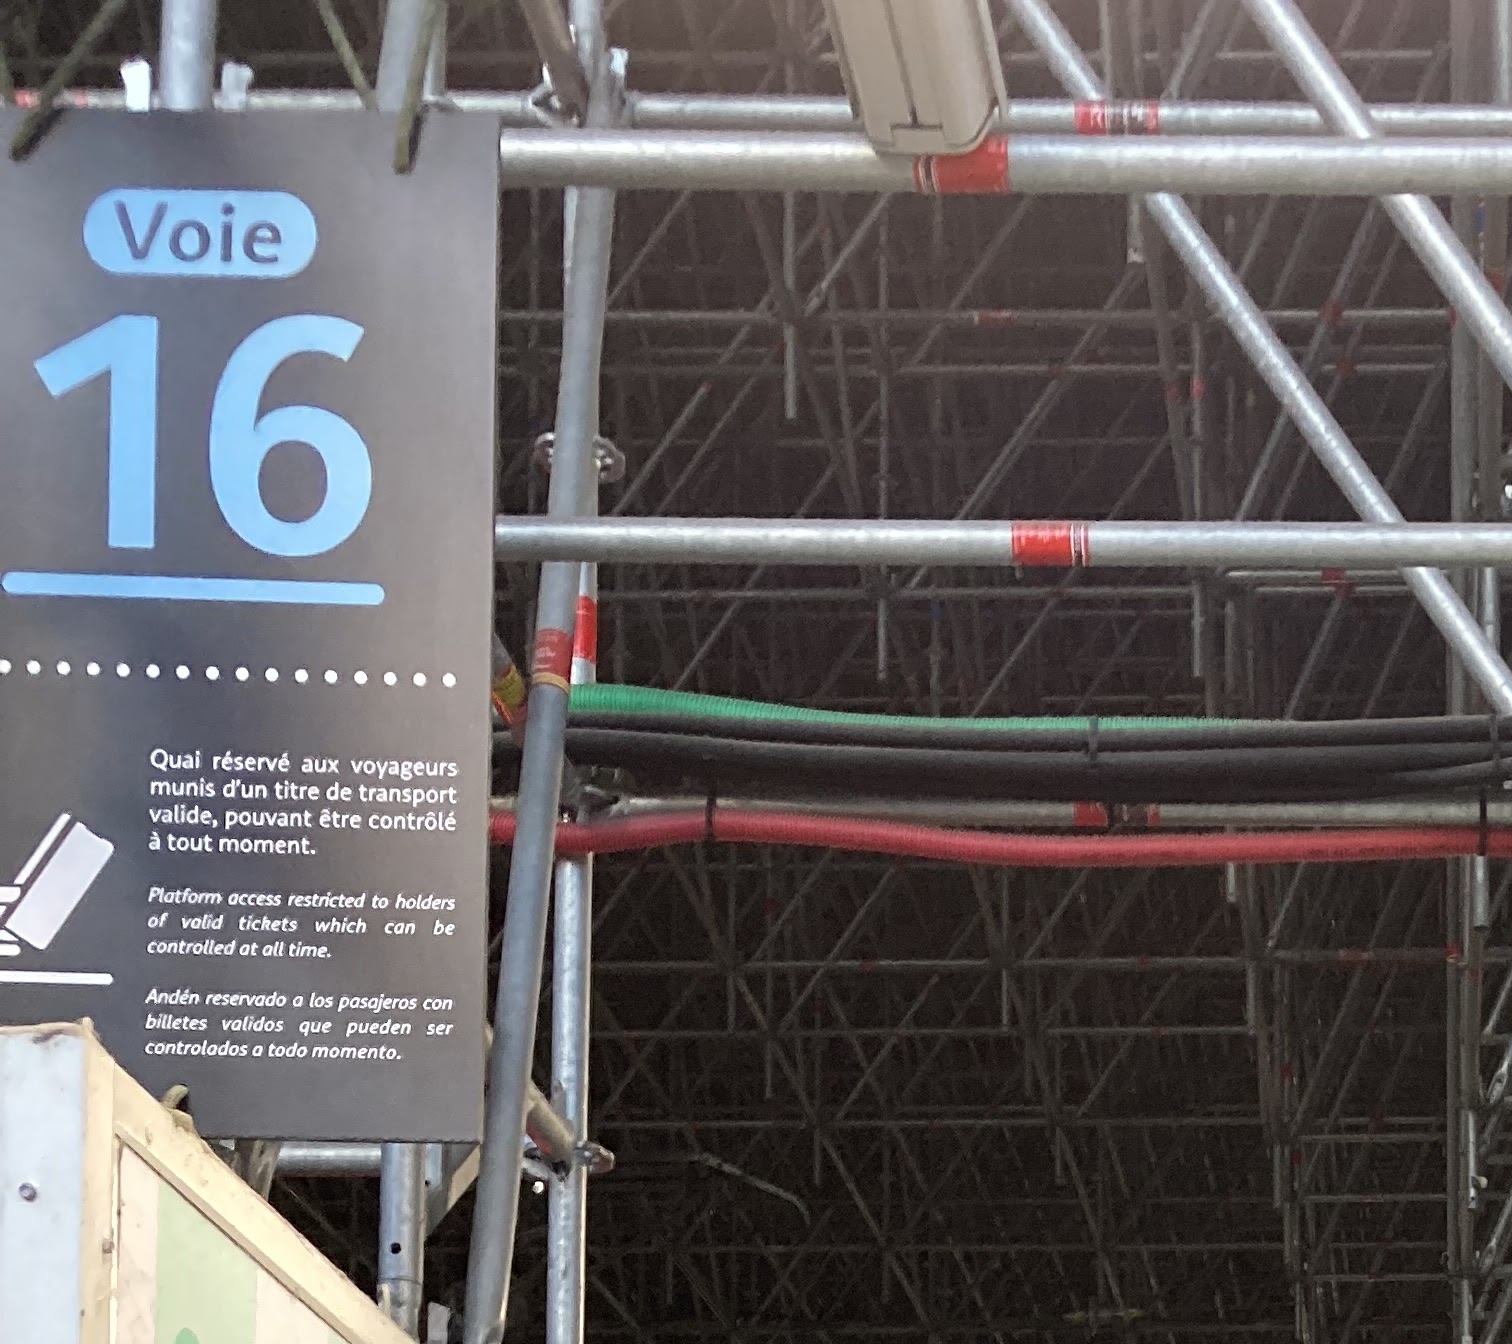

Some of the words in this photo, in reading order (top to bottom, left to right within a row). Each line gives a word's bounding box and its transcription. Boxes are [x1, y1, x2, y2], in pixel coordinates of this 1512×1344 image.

[115, 201, 283, 265] Voie
[33, 313, 373, 558] 16
[150, 748, 200, 771] Quai
[213, 750, 290, 772] réservé
[301, 757, 339, 774] aux
[351, 758, 458, 781] voyageurs
[150, 777, 215, 797] munis
[222, 779, 267, 799] d'un
[275, 780, 320, 801] titre
[326, 782, 352, 801] de
[359, 784, 457, 807] transport
[149, 804, 218, 828] valide,
[225, 809, 312, 830] pouvant
[319, 808, 362, 829] être
[368, 811, 457, 831] contrôlé
[149, 832, 160, 850] à
[167, 833, 213, 852] tout
[219, 837, 316, 855] moment.
[148, 887, 222, 905] Platform
[228, 892, 281, 907] access
[287, 891, 366, 909] restricted
[371, 894, 389, 910] to
[395, 893, 456, 911] holders
[147, 912, 169, 929] of
[181, 914, 224, 930] valid
[238, 915, 298, 932] tickets
[315, 917, 367, 934] which
[384, 921, 416, 935] can
[433, 918, 455, 936] be
[147, 939, 236, 956] controlled
[239, 942, 258, 957] at
[262, 941, 284, 957] all
[288, 941, 332, 958] time.
[145, 987, 200, 1005] Andén
[205, 991, 287, 1007] reservado
[292, 995, 304, 1008] a
[309, 992, 333, 1008] los
[337, 993, 418, 1014] pasajeros
[422, 997, 453, 1011] con
[145, 1013, 208, 1031] billetes
[222, 1015, 284, 1032] validos
[299, 1020, 332, 1037] que
[346, 1019, 412, 1038] pueden
[426, 1022, 454, 1036] ser
[145, 1039, 248, 1057] controlados
[252, 1046, 264, 1057] a
[268, 1042, 308, 1058] todo
[312, 1045, 402, 1060] momento.
